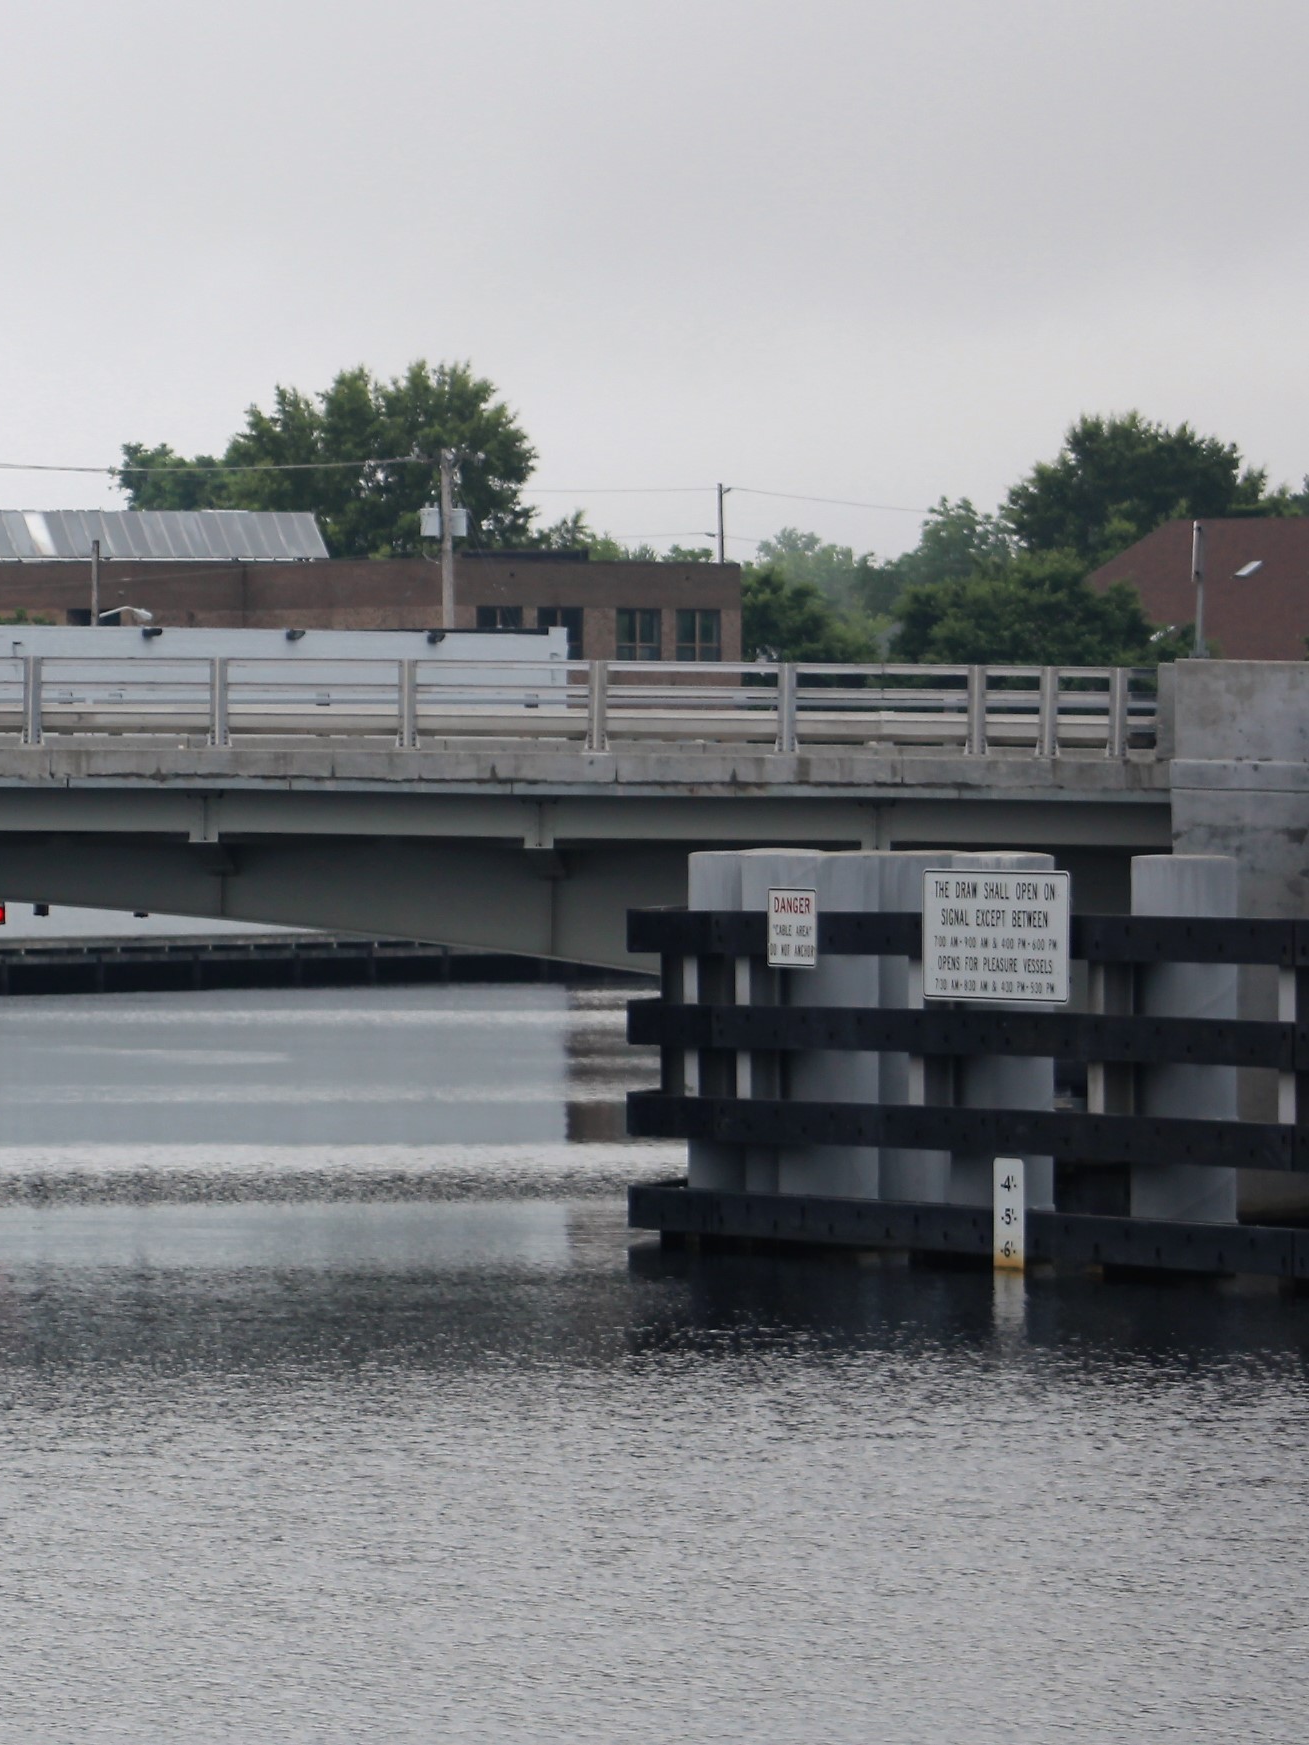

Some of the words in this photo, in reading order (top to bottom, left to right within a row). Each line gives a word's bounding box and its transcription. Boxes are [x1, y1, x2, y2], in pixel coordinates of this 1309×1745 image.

[934, 880, 950, 898] THE
[955, 881, 977, 899] DRAW
[983, 882, 1009, 900] SHALL
[1015, 882, 1037, 901] OPEN
[1044, 883, 1055, 901] ON
[774, 897, 810, 914] DANGER
[941, 908, 969, 926] SIGNAL
[976, 909, 1005, 927] EXCEPT
[1011, 910, 1048, 928] BETWEEN
[1048, 939, 1058, 951] PM
[937, 955, 960, 971] OPENS
[965, 956, 978, 972] FOR
[982, 957, 1018, 973] PLEASURE
[1023, 958, 1053, 974] VESSELS
[1046, 982, 1056, 994] PM
